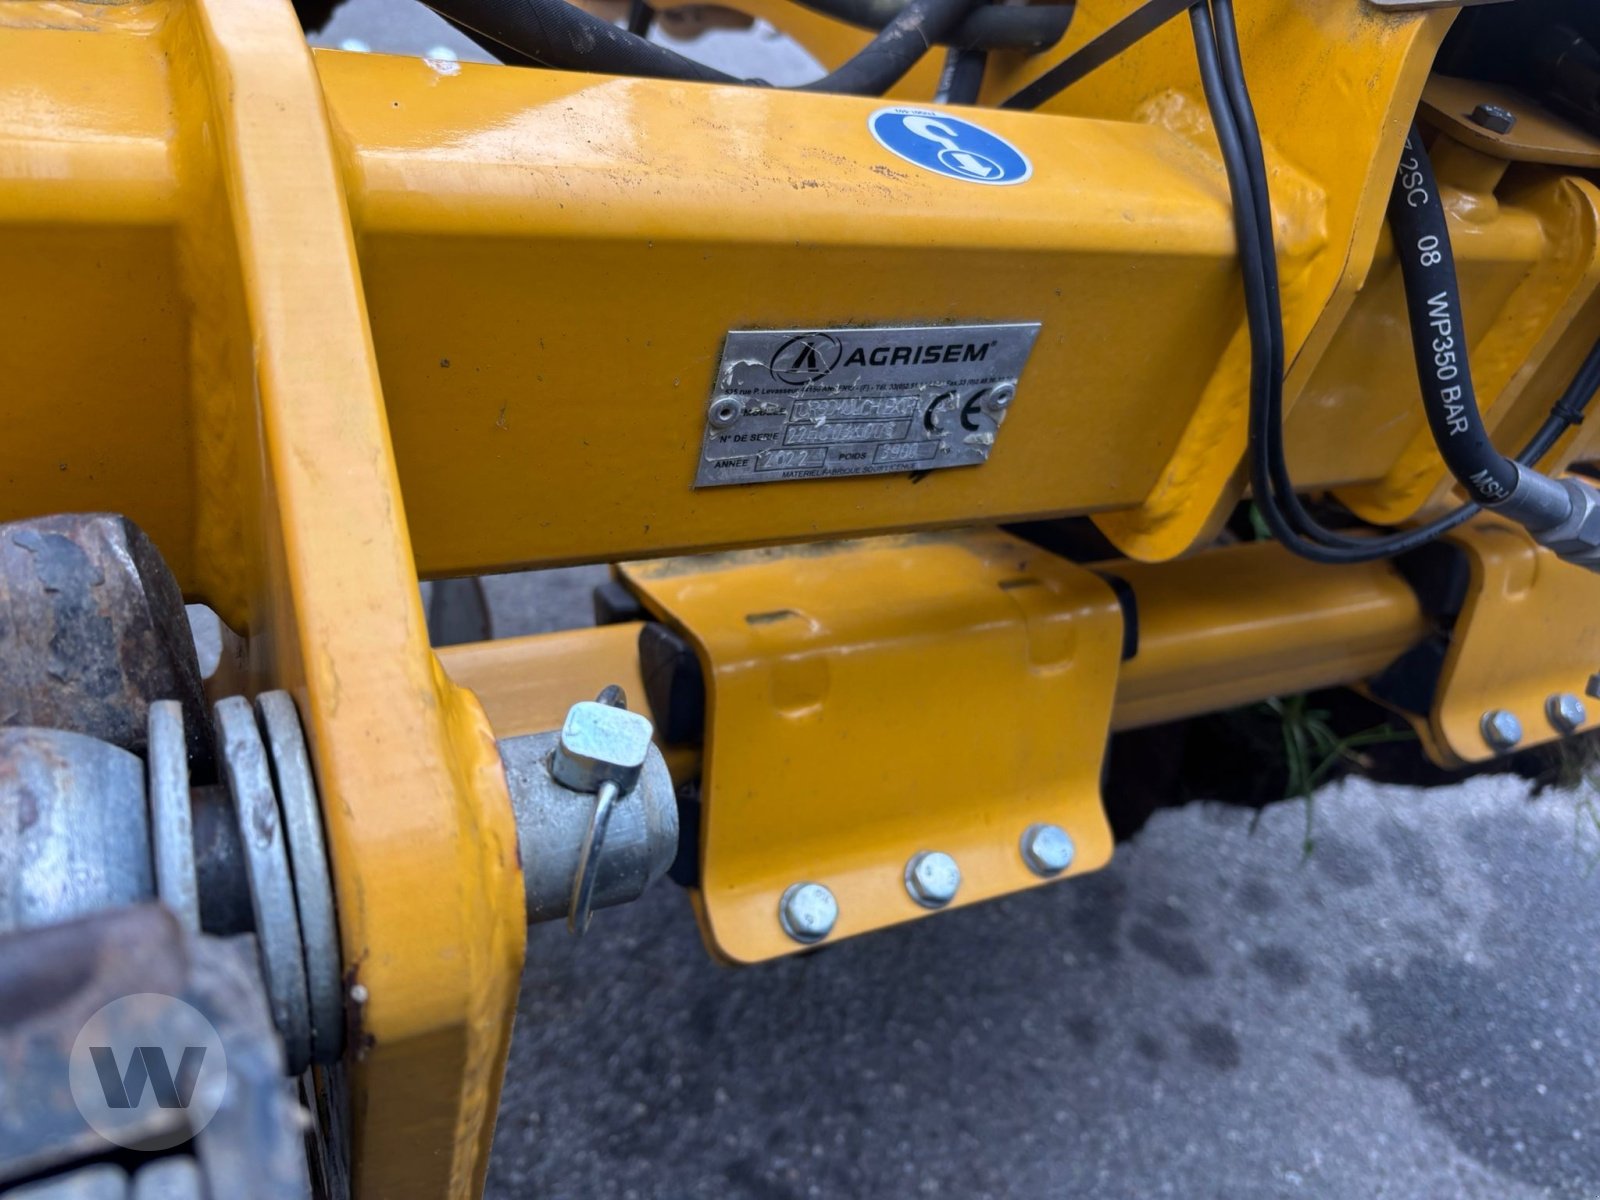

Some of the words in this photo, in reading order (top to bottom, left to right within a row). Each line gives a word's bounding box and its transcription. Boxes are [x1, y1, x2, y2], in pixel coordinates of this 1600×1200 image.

[1417, 235, 1442, 267] 08
[1427, 291, 1458, 381] WP350
[843, 343, 989, 367] AGRISEM
[1440, 384, 1469, 437] BAR
[734, 433, 748, 442] DE
[838, 452, 867, 461] POIDS
